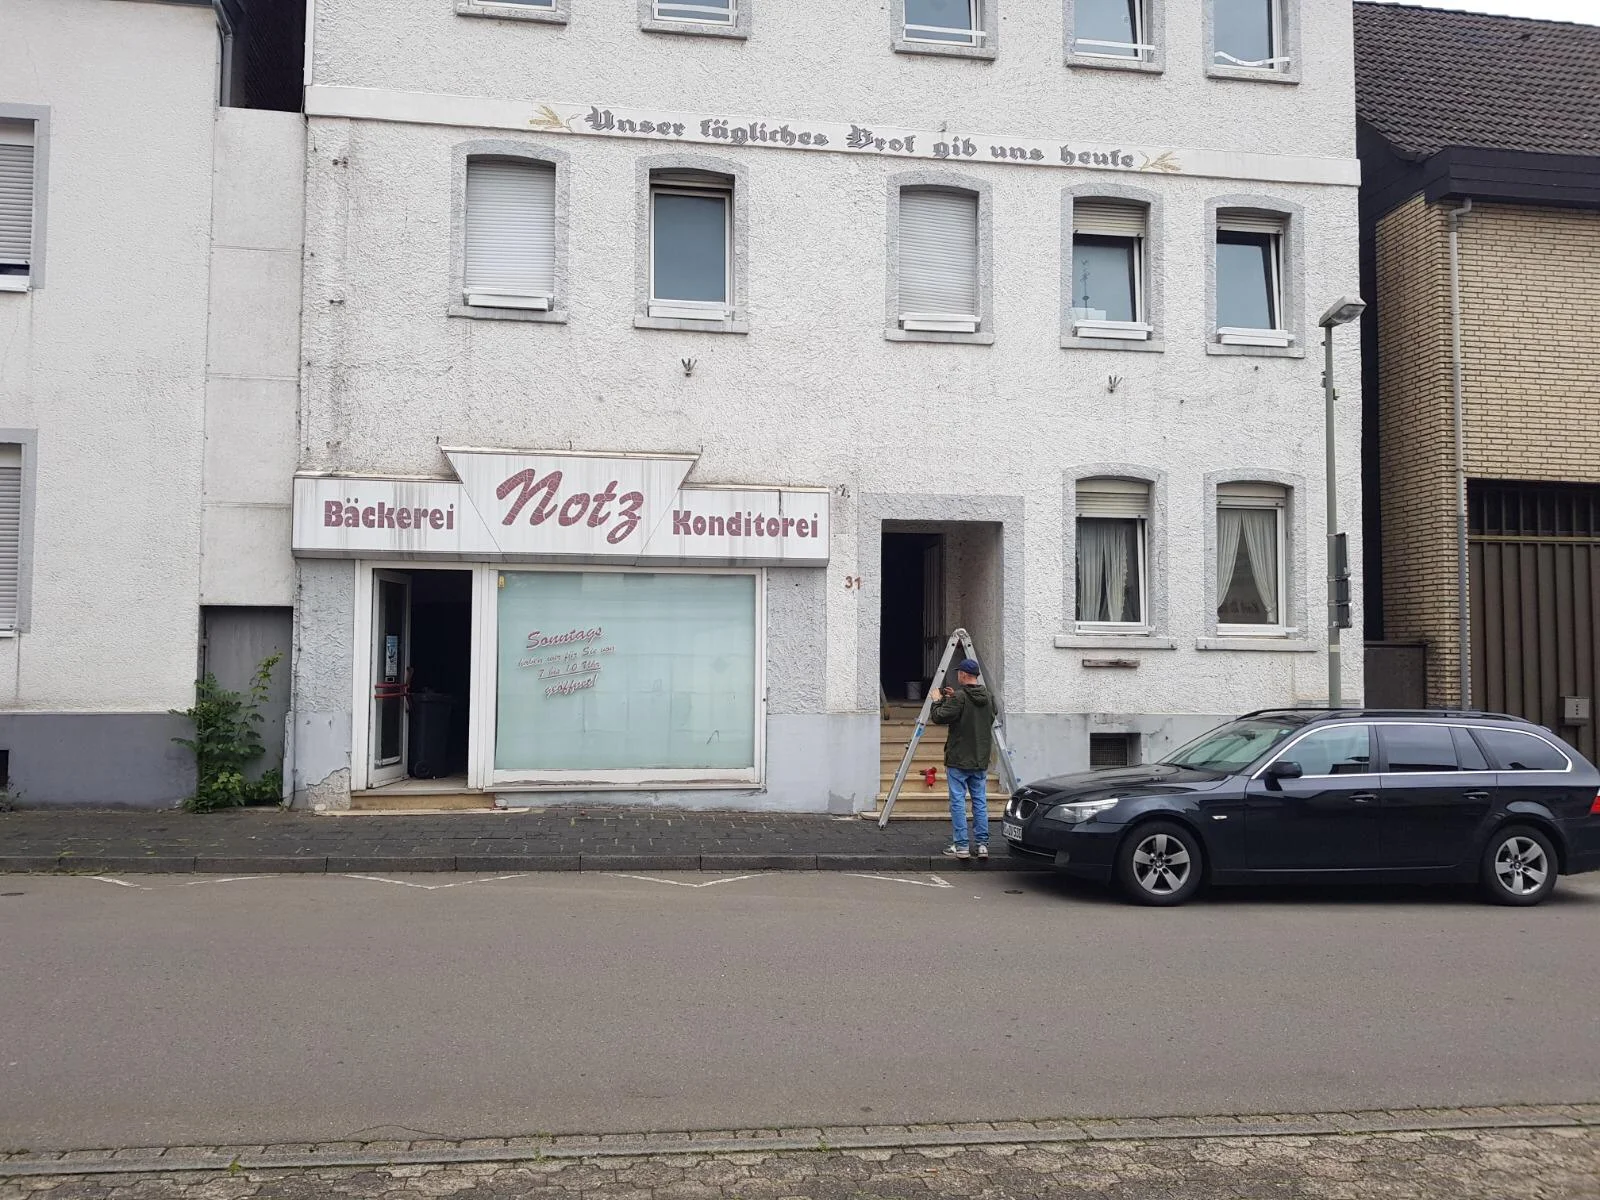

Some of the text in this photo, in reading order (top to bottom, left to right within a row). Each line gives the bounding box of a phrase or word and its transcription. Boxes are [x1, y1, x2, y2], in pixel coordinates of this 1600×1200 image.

[584, 105, 1135, 168] Unser tägliches Brot gib uns heute
[324, 497, 454, 530] Bäckerei
[495, 468, 644, 545] Notz
[672, 509, 818, 538] Konditorei
[845, 576, 861, 590] 31
[526, 627, 603, 650] Sonntags
[582, 646, 597, 657] Sie
